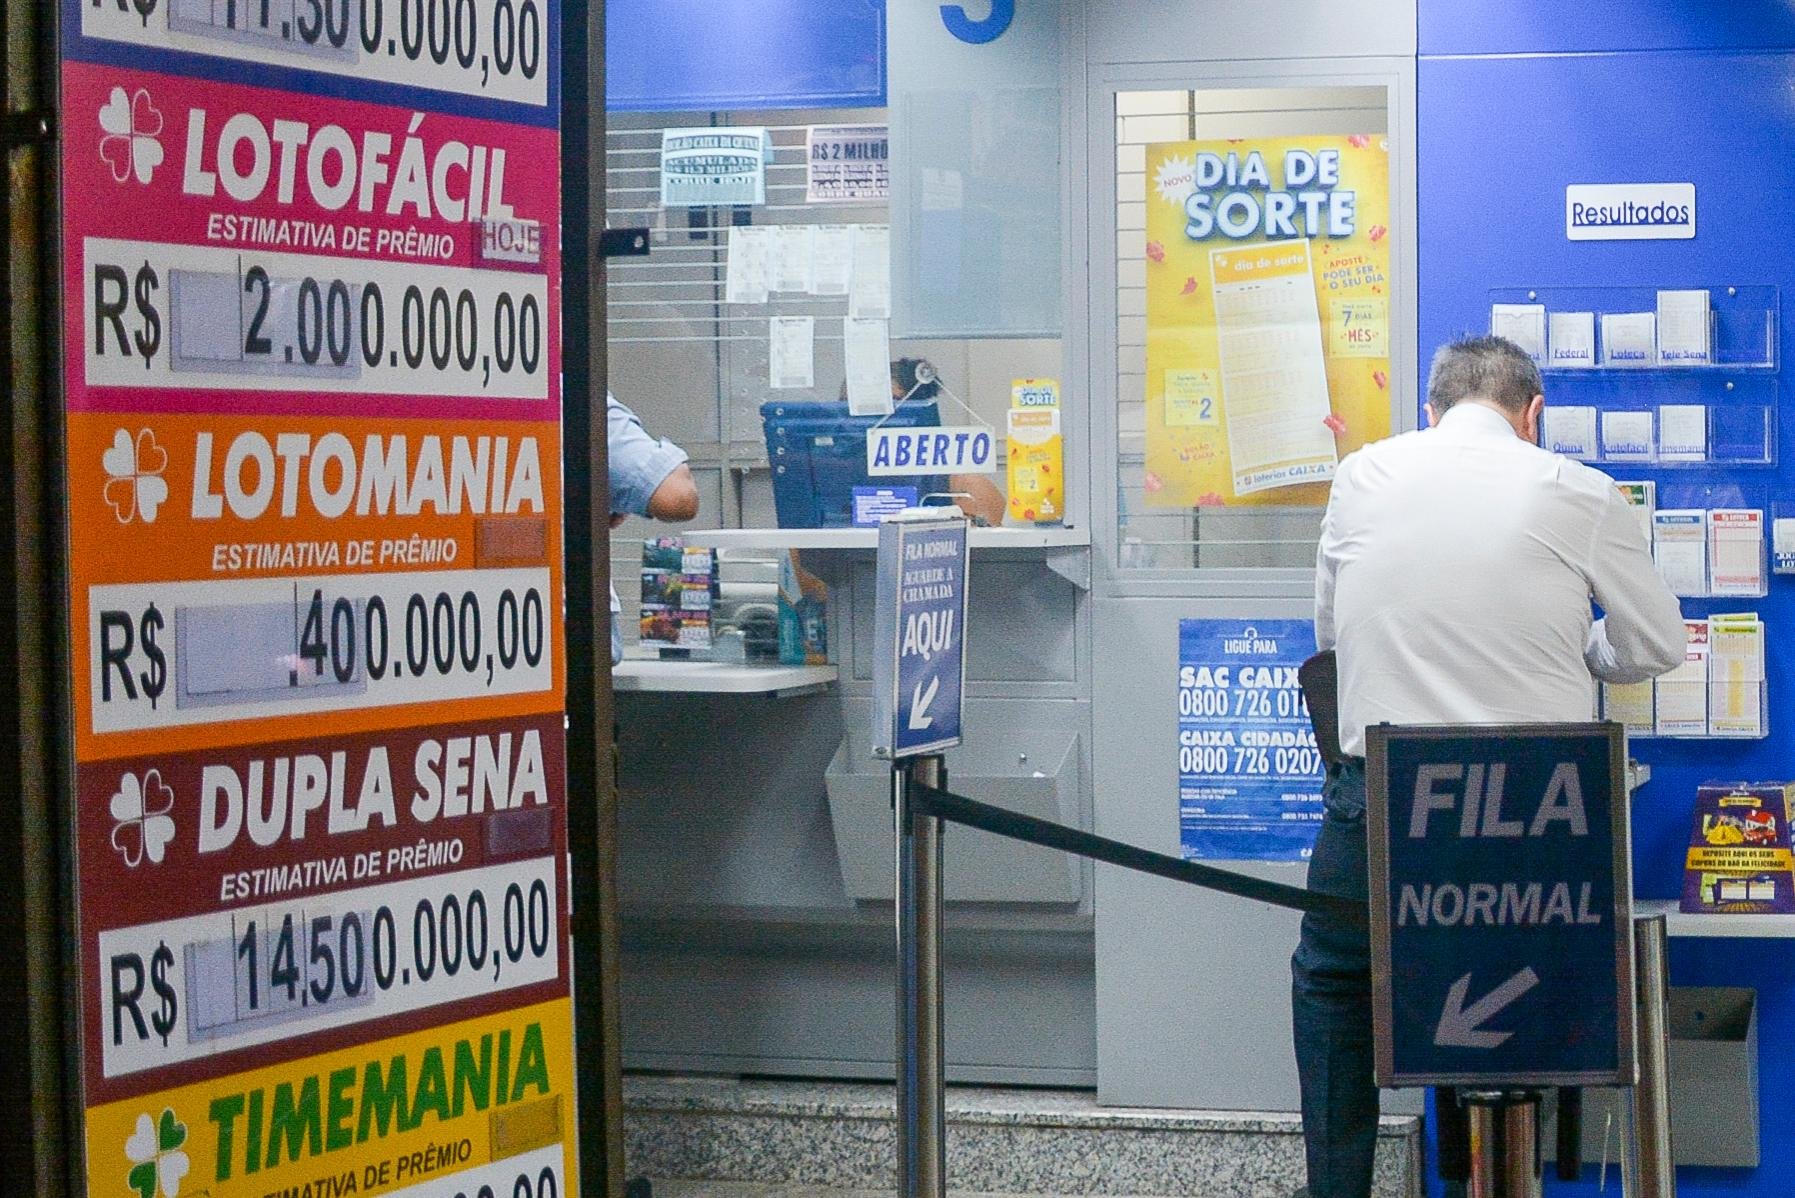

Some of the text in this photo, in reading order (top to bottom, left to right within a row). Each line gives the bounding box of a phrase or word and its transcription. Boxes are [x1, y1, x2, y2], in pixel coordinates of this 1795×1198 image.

[182, 108, 513, 222] LOTOFÁCIL
[832, 144, 840, 160] 2
[844, 138, 889, 160] MILHÕ
[1163, 174, 1192, 188] NOVO
[1196, 149, 1339, 192] DIA DE
[1184, 190, 1356, 239] SORTE
[1571, 200, 1690, 225] Resultados
[207, 213, 455, 260] ESTIMATIVA DE PRÊMIO
[483, 221, 540, 255] HOJE
[94, 260, 161, 369] R$
[1342, 310, 1352, 327] 7
[1553, 349, 1590, 359] Federal
[1200, 398, 1212, 419] 2
[873, 432, 991, 467] ABERTO
[1553, 441, 1584, 453] Quina
[191, 431, 545, 520] LOTOMANIA
[1288, 464, 1326, 477] CAIXA
[212, 533, 458, 572] ESTIMATIVA DE PRÊMIO
[901, 609, 954, 661] AQUI
[1224, 639, 1277, 654] LIGUE PARA
[100, 602, 168, 709] R$
[1180, 666, 1302, 688] SAC CAIX
[1179, 689, 1229, 716] 0800
[1234, 689, 1272, 717] 726
[1179, 730, 1236, 746] CAIXA
[1179, 747, 1322, 774] 0800 726 0207
[199, 729, 549, 853] DUPLA SENA
[1408, 763, 1589, 838] FILA
[221, 838, 465, 901] ESTIMATIVA DE PRÊMIO
[1399, 882, 1601, 926] NORMAL
[111, 940, 178, 1046] R$
[209, 1022, 550, 1183] TIMEMANIA
[363, 1161, 390, 1190] DE
[397, 1137, 473, 1178] PRÊMIO
